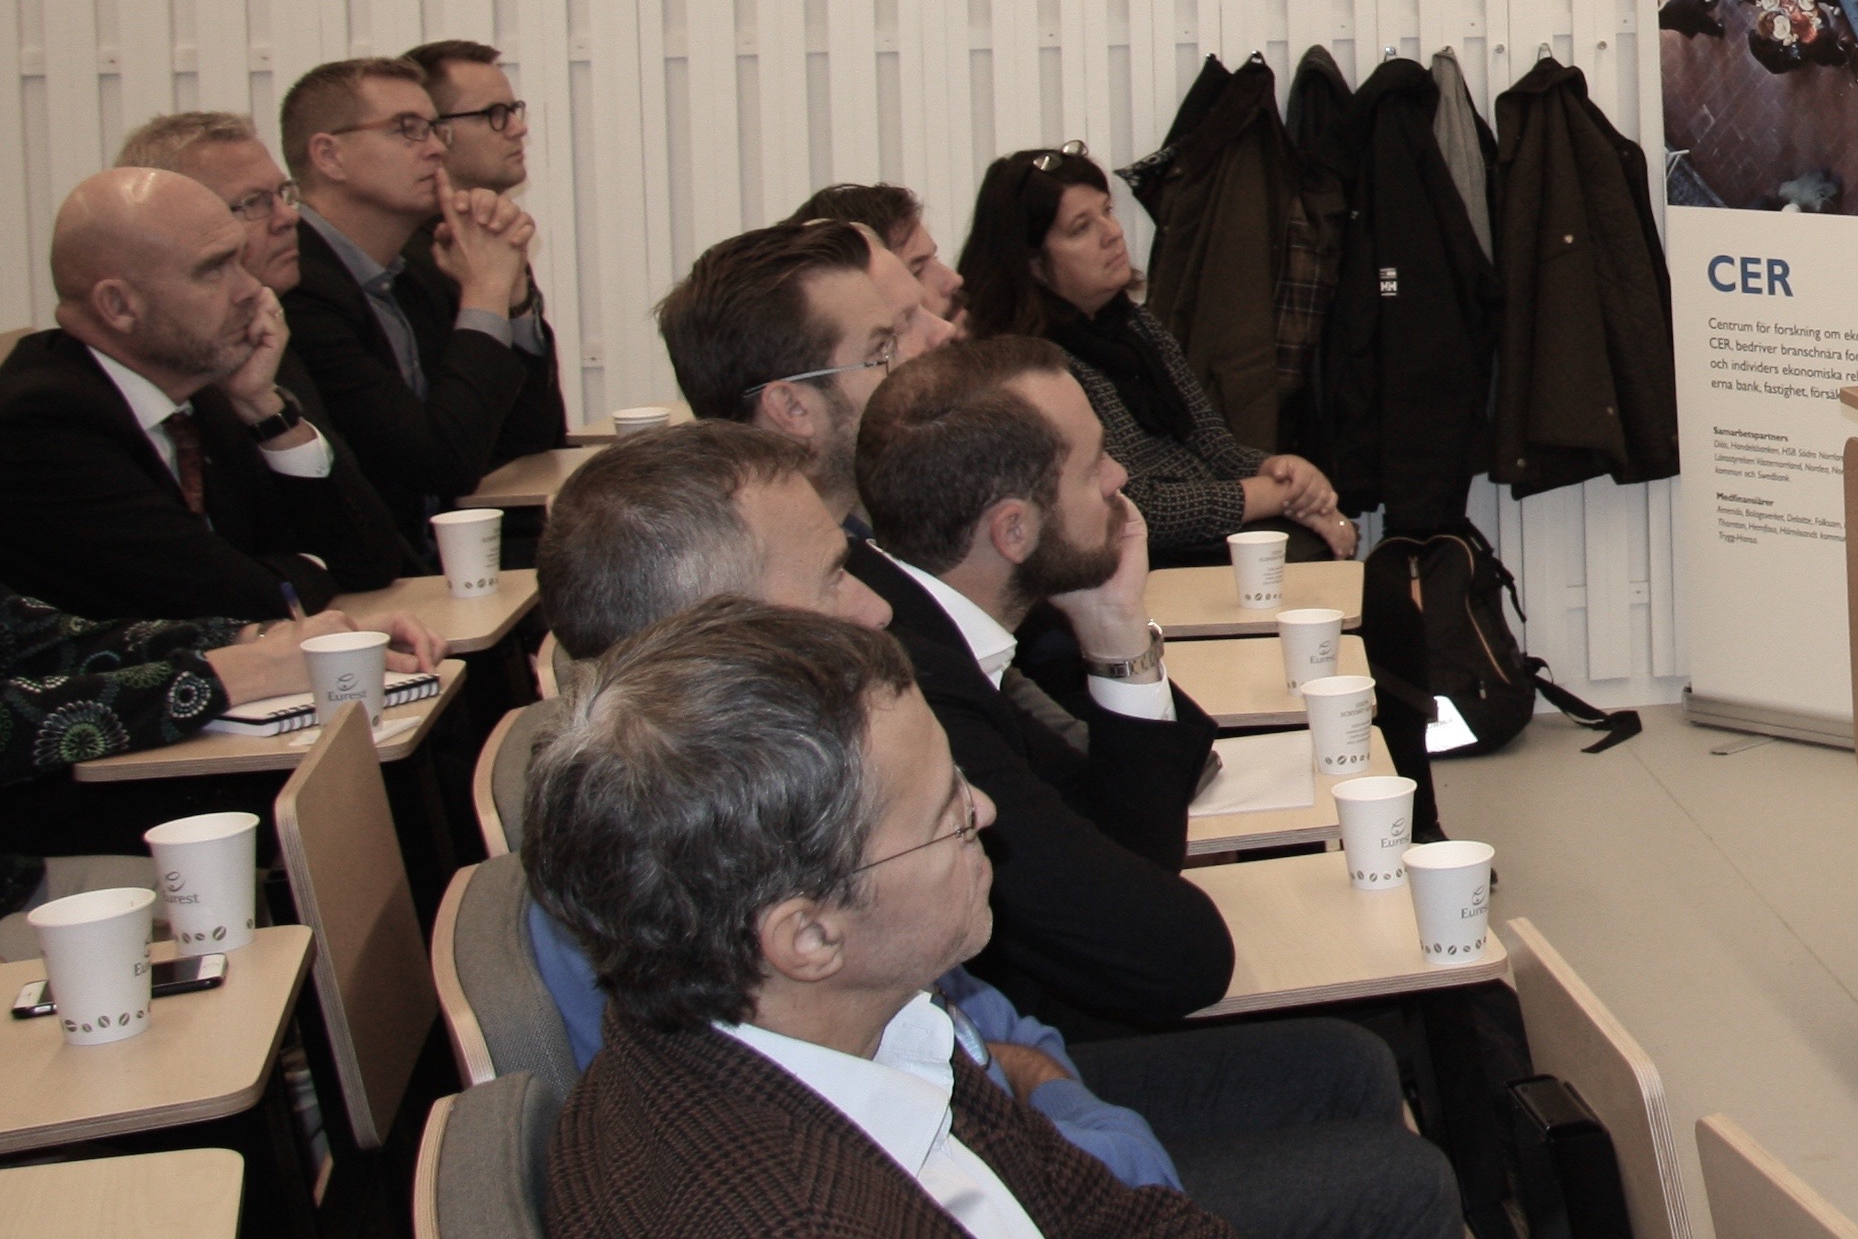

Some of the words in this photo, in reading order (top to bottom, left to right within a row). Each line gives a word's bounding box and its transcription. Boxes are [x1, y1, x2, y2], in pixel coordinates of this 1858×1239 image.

[1708, 255, 1793, 297] CER
[1708, 317, 1753, 332] Centrum
[1756, 321, 1770, 333] för
[1774, 323, 1821, 341] forskning
[1824, 330, 1840, 340] om
[1736, 340, 1777, 354] bedriver
[1781, 344, 1842, 360] branschnära
[1710, 359, 1728, 370] och
[1731, 359, 1779, 374] individers
[1782, 364, 1842, 381] ekonomiska
[1711, 380, 1733, 390] erna
[1736, 379, 1761, 393] bank,
[1713, 426, 1789, 442] Samarbetspartners
[327, 690, 368, 702] Eurest
